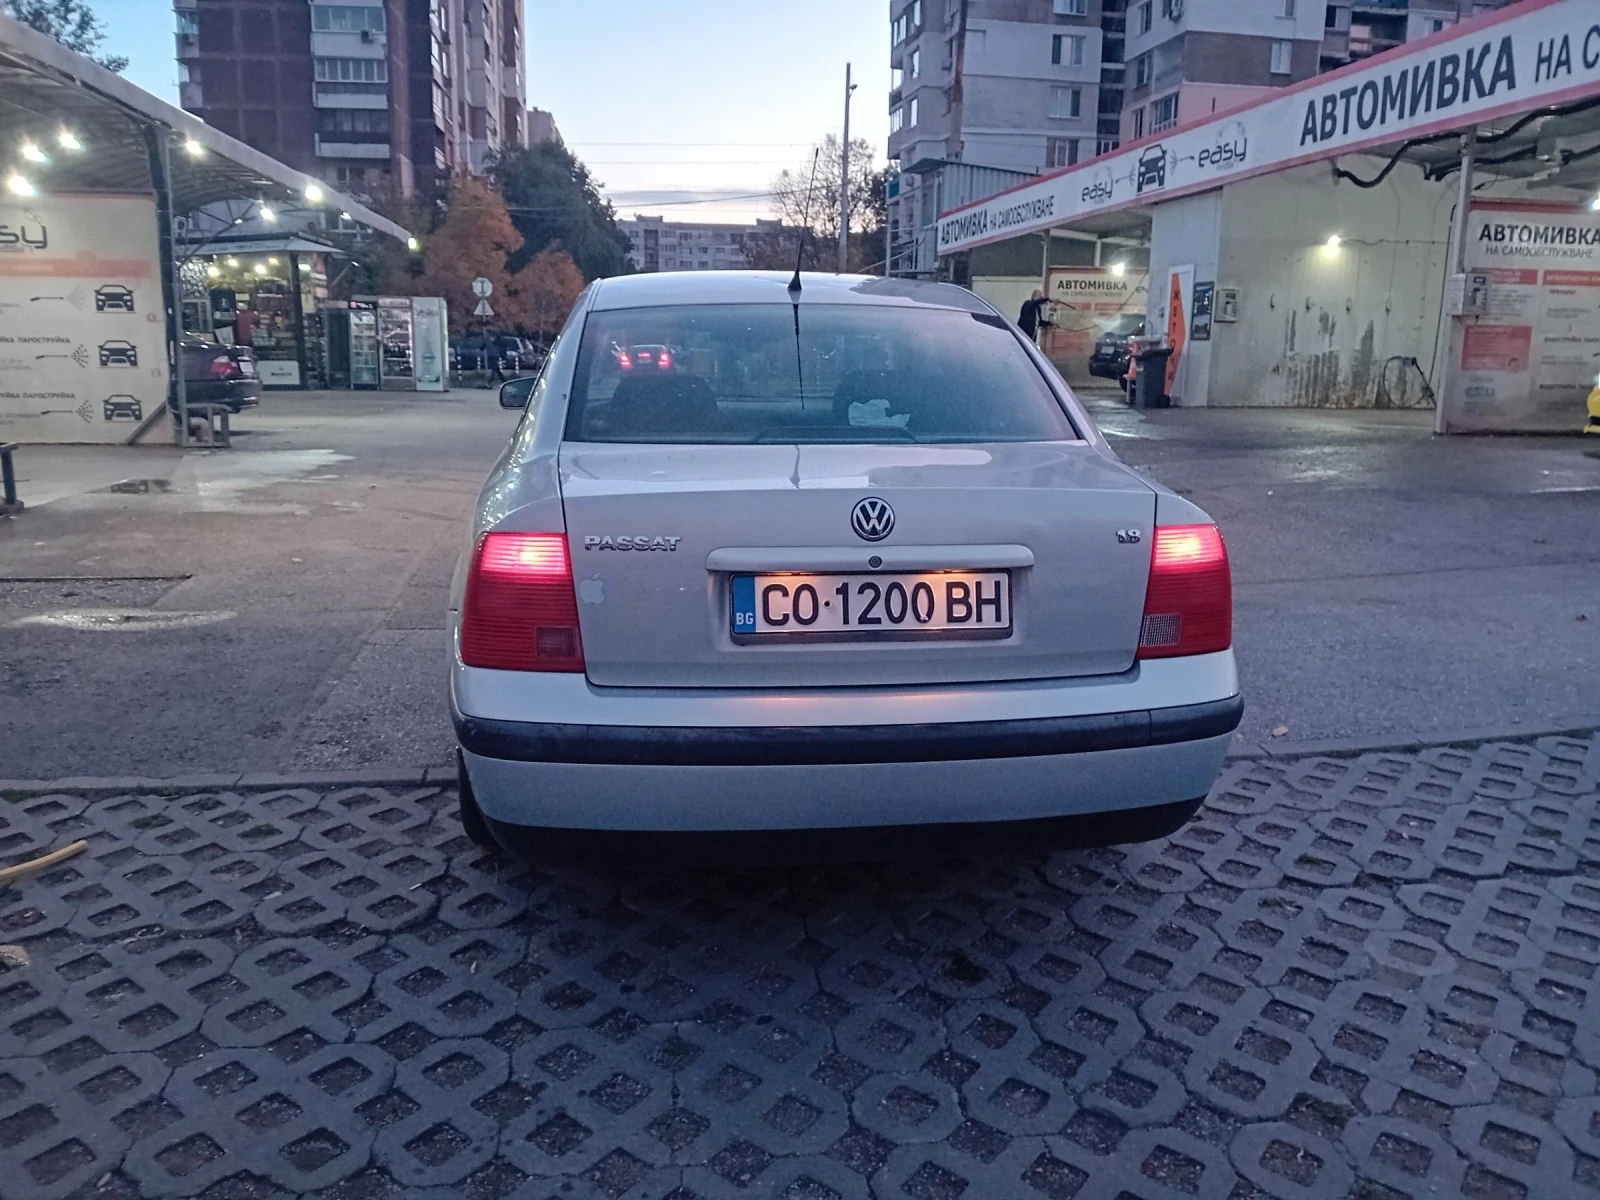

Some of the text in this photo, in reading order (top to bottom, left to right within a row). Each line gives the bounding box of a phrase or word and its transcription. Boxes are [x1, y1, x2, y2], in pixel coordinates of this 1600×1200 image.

[1300, 35, 1517, 146] АВТОМИВКА
[1534, 33, 1573, 83] НА
[1198, 137, 1248, 168] easy
[1081, 179, 1114, 202] easy
[940, 208, 988, 246] АВТОМИВКА
[1479, 223, 1600, 246] АВТОМИВКА
[1486, 245, 1595, 259] НА САМООБСЛУЖВАНЕ
[1057, 280, 1128, 291] АВТОМИВКА
[583, 534, 682, 552] PASSAT
[762, 580, 1002, 626] CO 1200 BH
[735, 612, 754, 626] BG
